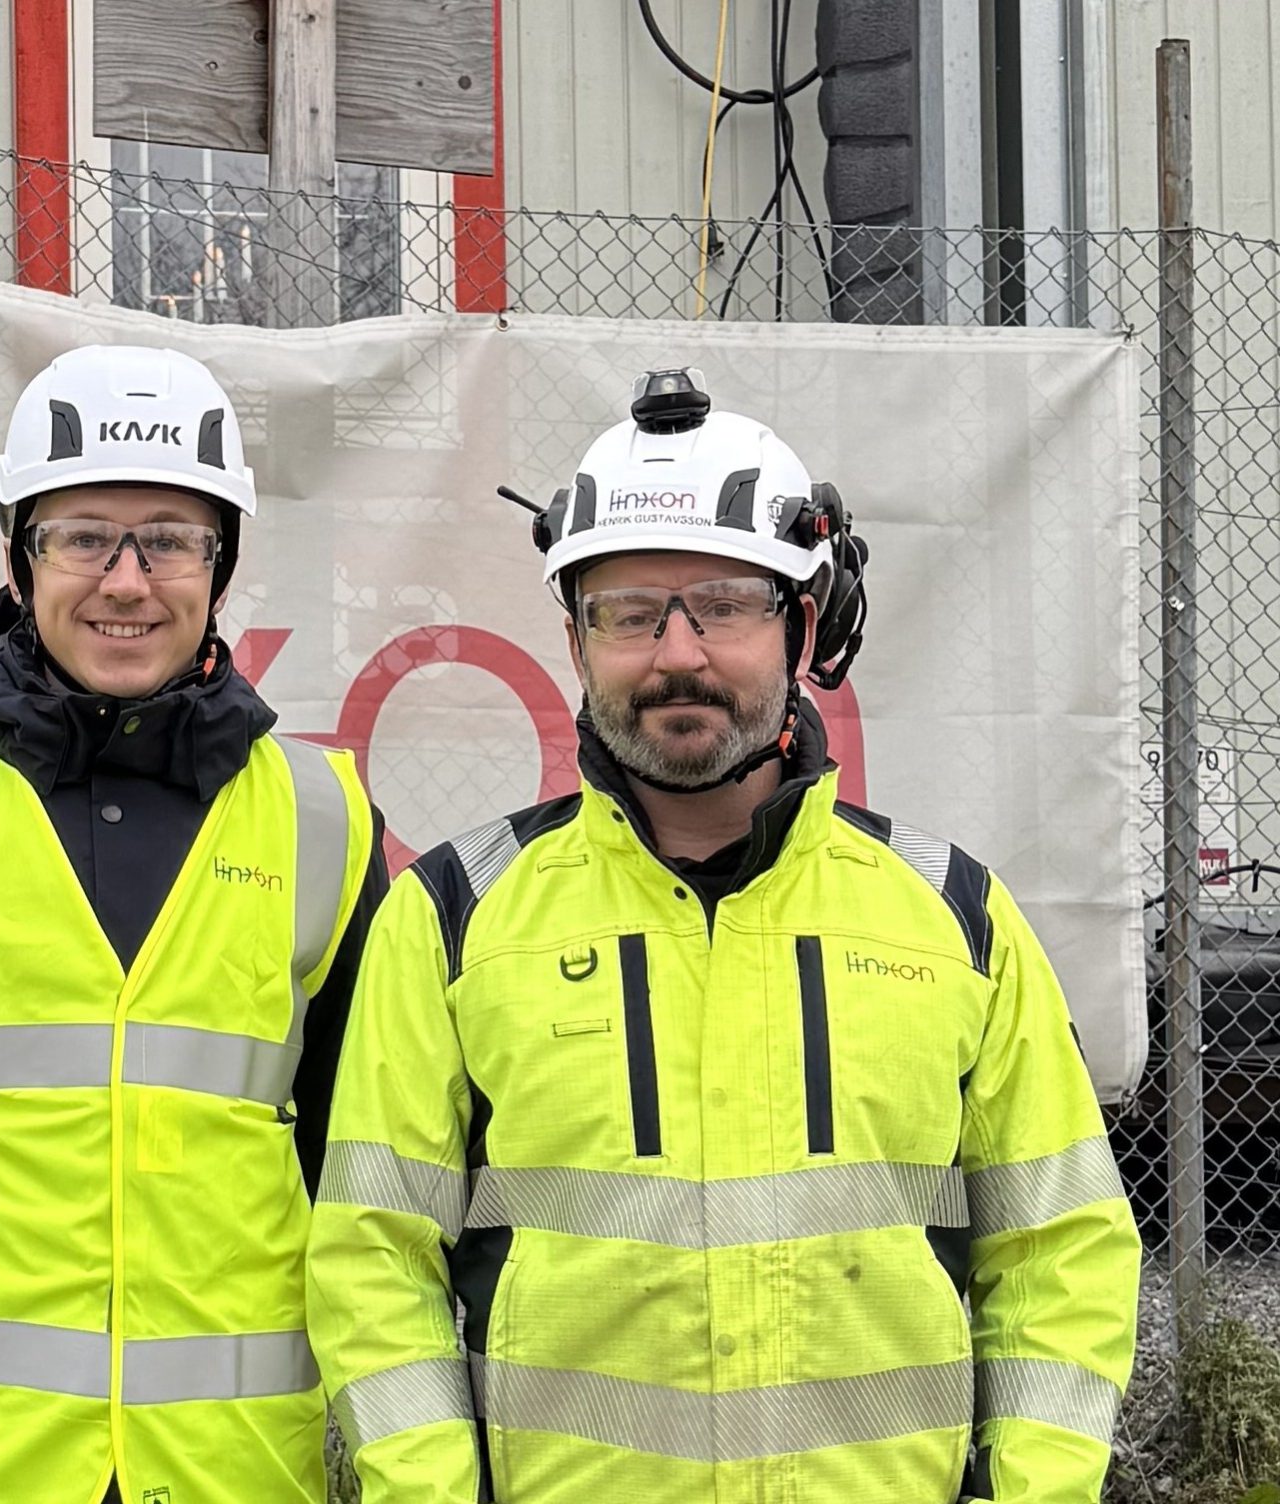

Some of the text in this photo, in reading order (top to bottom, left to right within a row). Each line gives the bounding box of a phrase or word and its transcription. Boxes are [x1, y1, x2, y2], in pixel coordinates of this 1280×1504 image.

[100, 421, 182, 446] KASK
[609, 488, 695, 512] linxon
[634, 513, 712, 527] GUSTAVSSON
[846, 950, 935, 983] linxon
